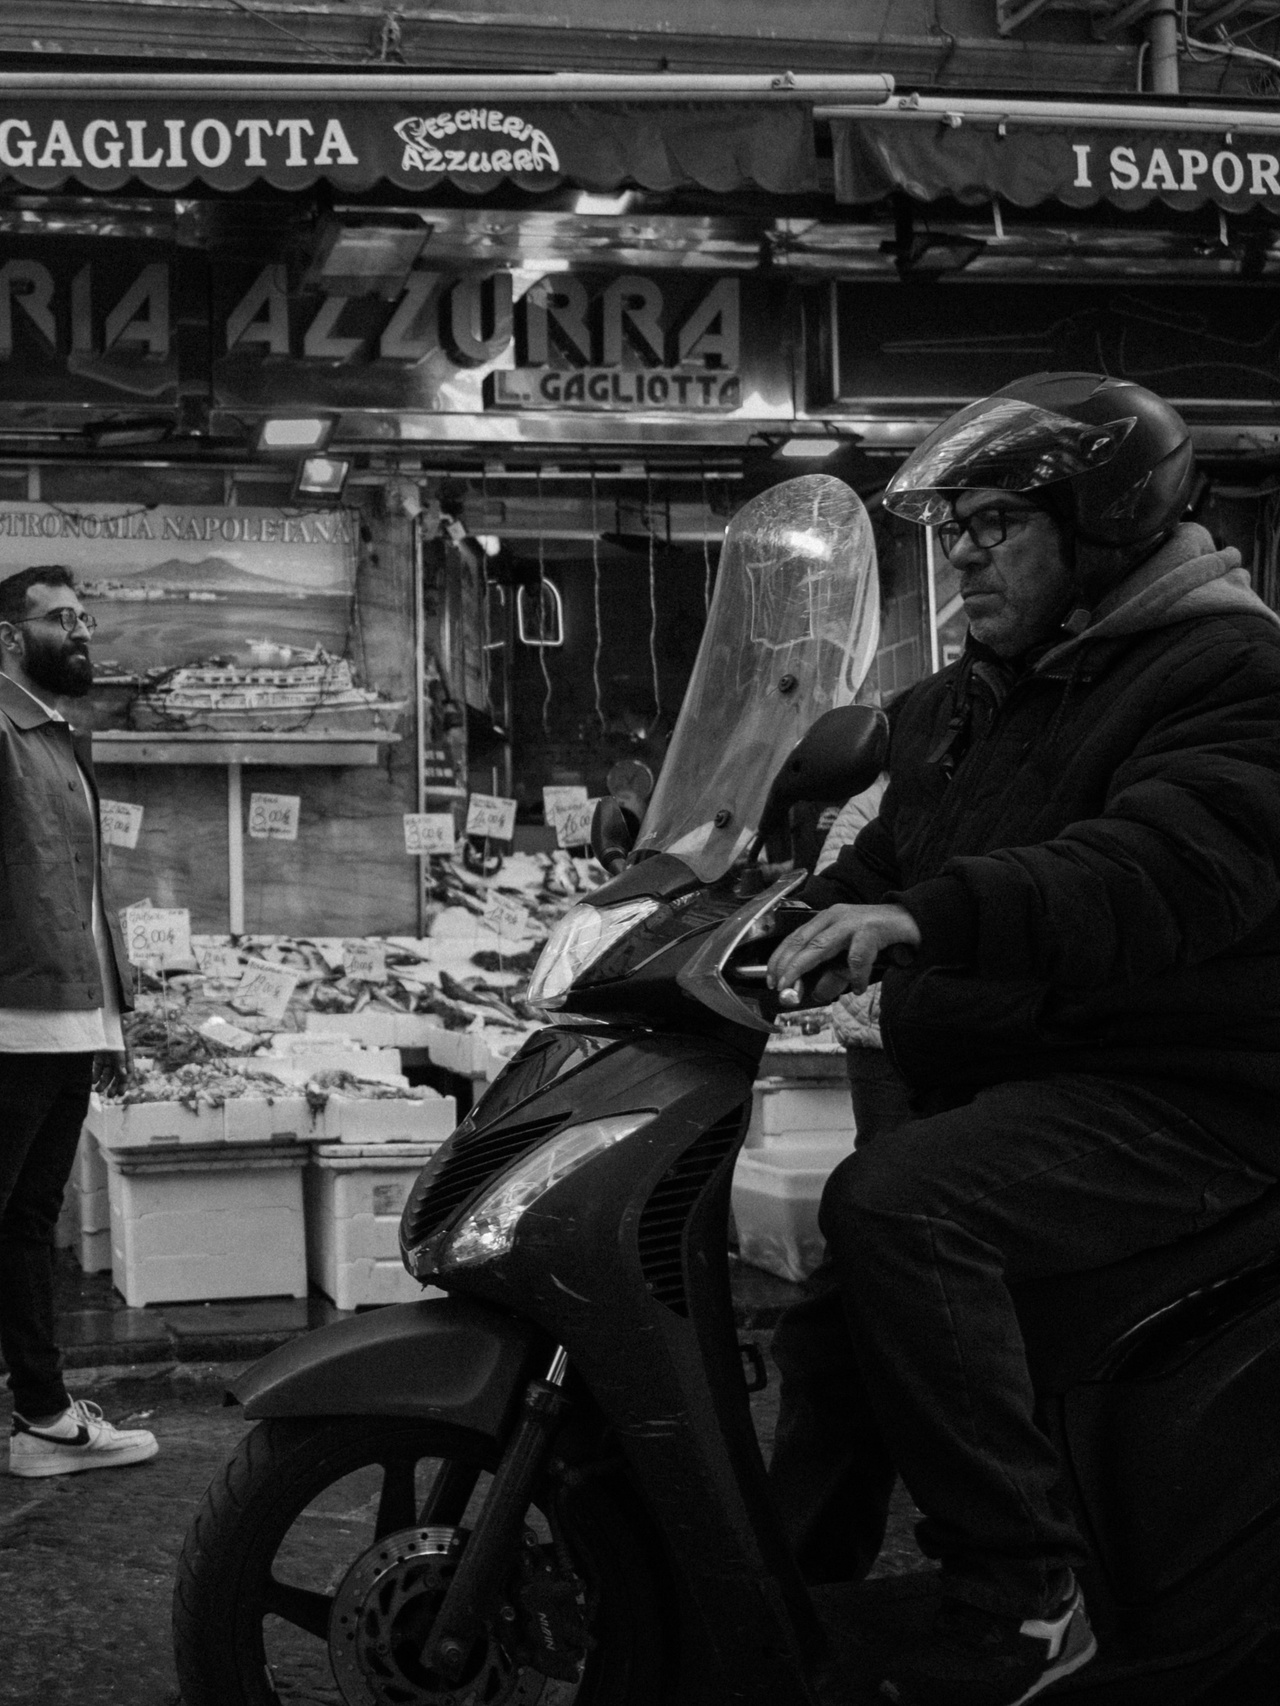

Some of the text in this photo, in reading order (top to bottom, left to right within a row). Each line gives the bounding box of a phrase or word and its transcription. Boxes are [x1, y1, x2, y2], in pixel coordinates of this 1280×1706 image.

[401, 133, 560, 173] AZZURRA
[1072, 144, 1092, 188] I
[226, 263, 741, 370] AZZURRA
[497, 370, 741, 405] L. GAGLIOTTA
[161, 515, 352, 543] NAPOLETANA
